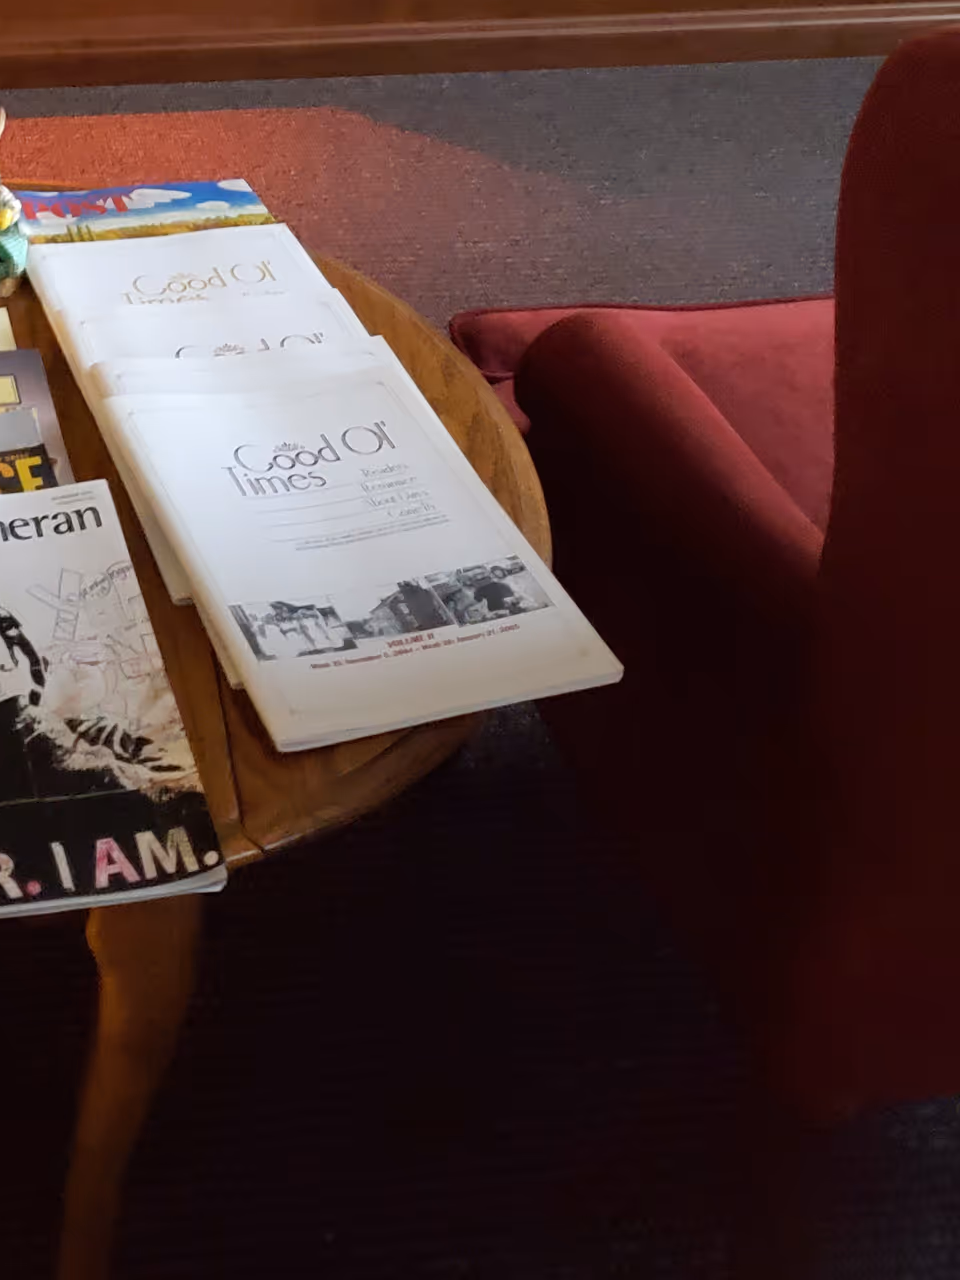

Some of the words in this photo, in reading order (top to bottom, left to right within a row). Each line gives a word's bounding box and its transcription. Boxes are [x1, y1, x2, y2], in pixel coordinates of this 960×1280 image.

[221, 465, 328, 497] Times
[49, 840, 77, 894] I
[93, 824, 221, 890] AM.
